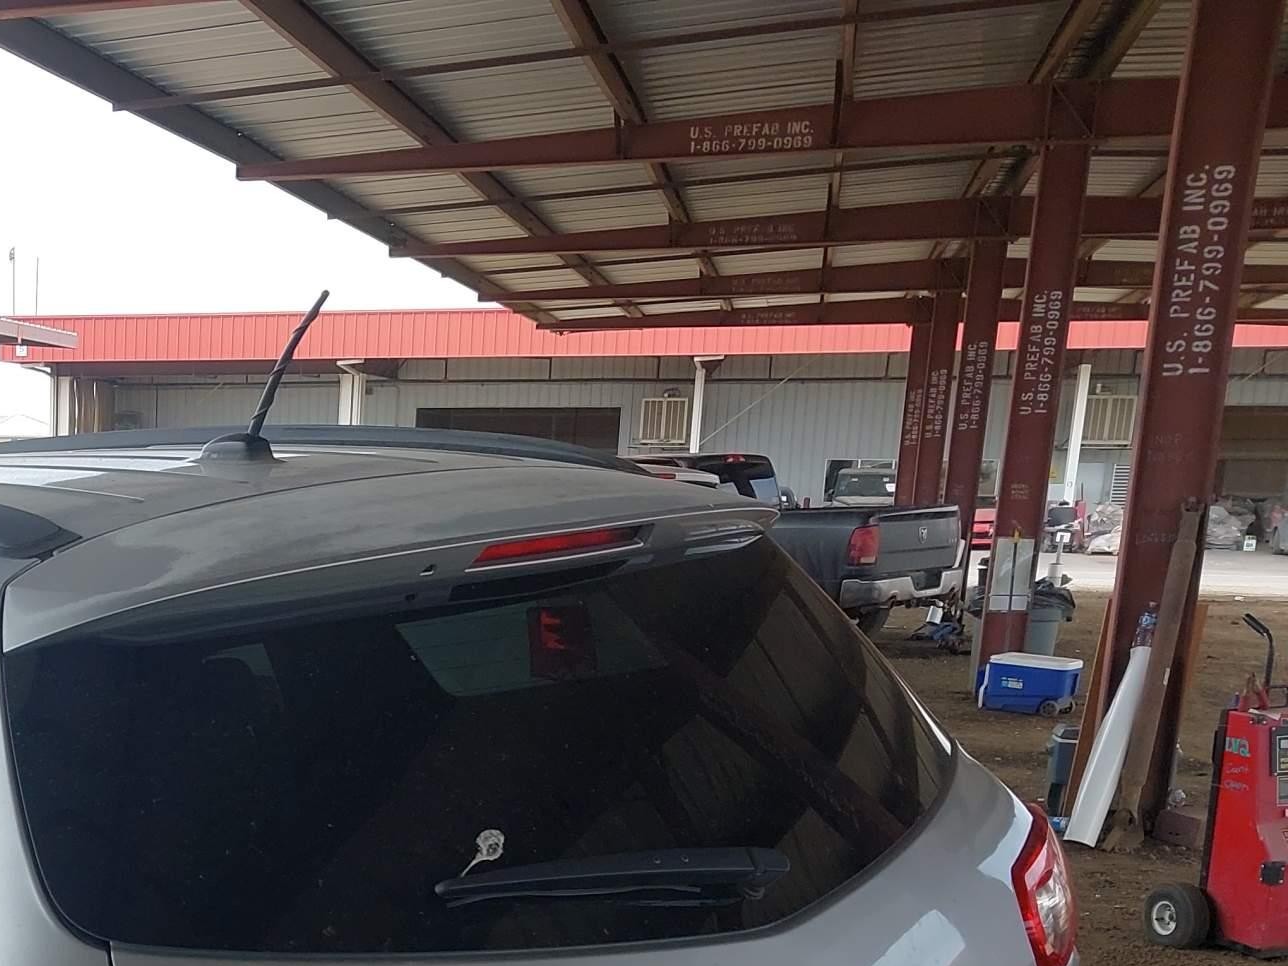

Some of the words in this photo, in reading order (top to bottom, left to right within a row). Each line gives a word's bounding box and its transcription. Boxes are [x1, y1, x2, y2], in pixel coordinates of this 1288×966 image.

[690, 135, 813, 153] 1-866-799-0969
[724, 122, 780, 137] PREFAB
[786, 120, 814, 135] INC.
[1182, 164, 1210, 211] INC.
[1169, 224, 1200, 318] PREFAB
[1188, 165, 1236, 374] 1-866-799-0969
[1032, 290, 1048, 317] INC.
[1024, 324, 1043, 380] PREFAB
[1034, 290, 1063, 413] 1-866-799-0969
[1162, 332, 1187, 376] U.S.
[961, 365, 975, 405] PREFAB
[1019, 387, 1034, 415] U.S.
